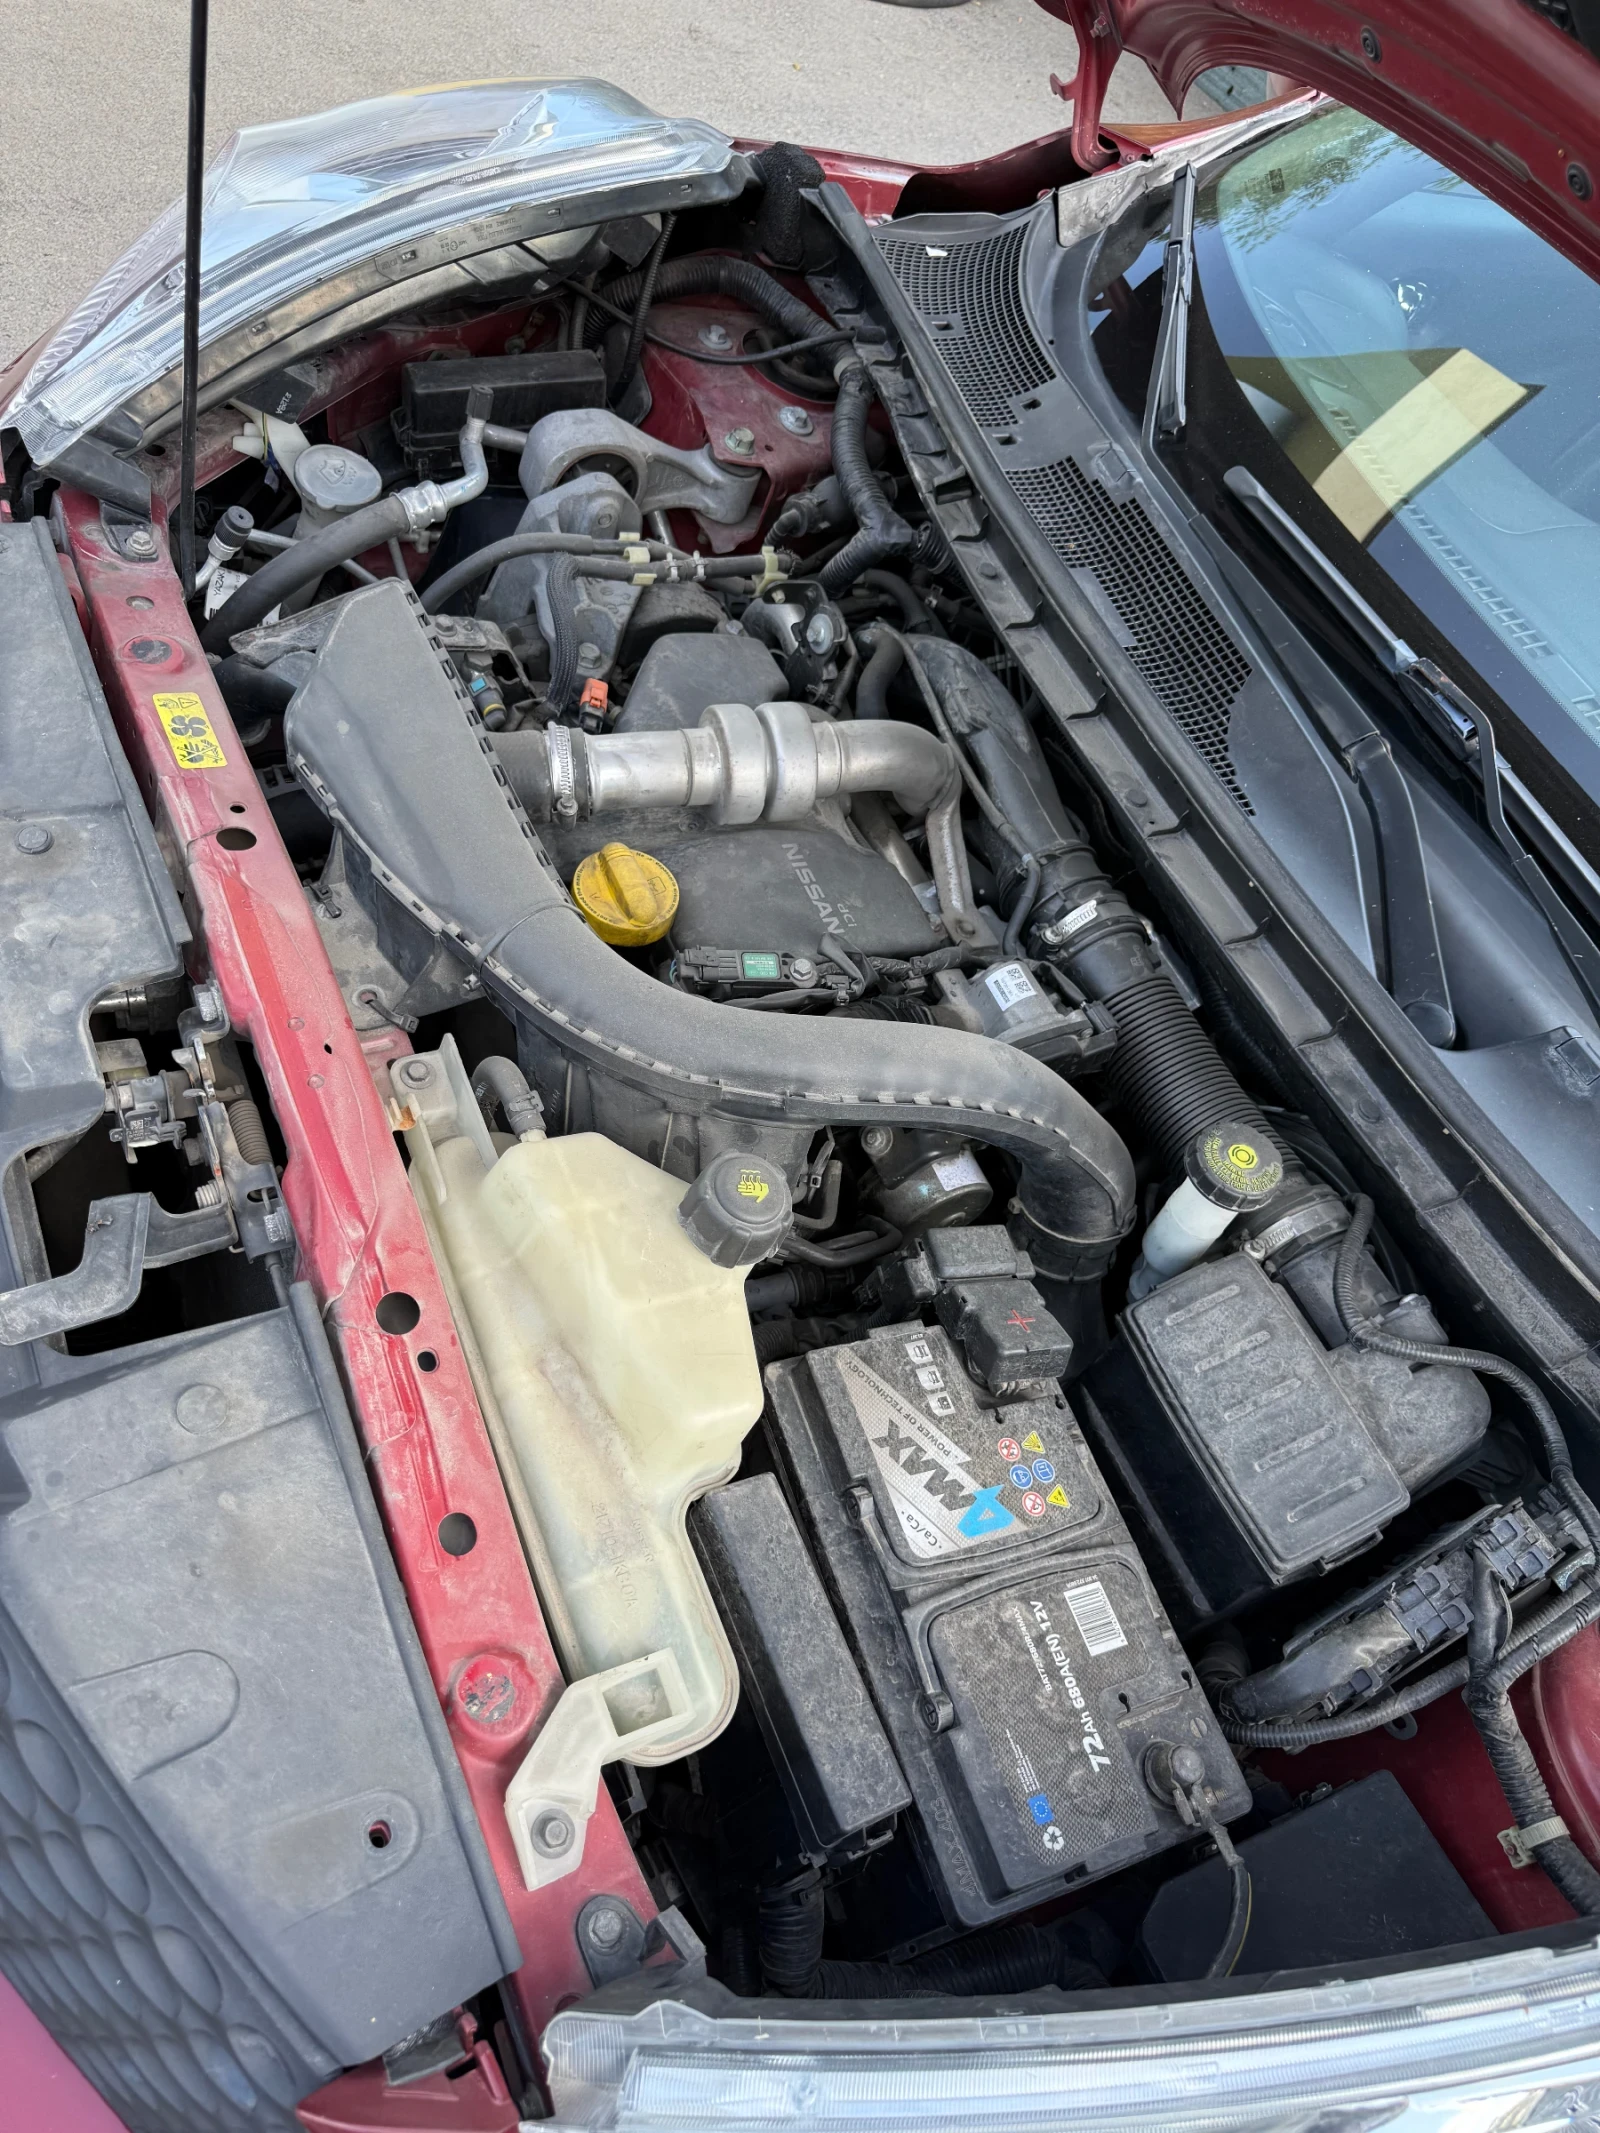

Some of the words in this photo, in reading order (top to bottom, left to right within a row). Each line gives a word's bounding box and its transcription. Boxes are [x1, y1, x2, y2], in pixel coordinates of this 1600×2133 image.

[781, 843, 845, 932] NISSAN
[837, 905, 857, 927] dCi
[846, 1359, 904, 1413] TECHNOLOGY
[903, 1412, 919, 1426] OF
[917, 1424, 953, 1457] POWER
[871, 1418, 1015, 1540] 4MAX
[906, 1514, 937, 1547] Ca/Ca
[1029, 1601, 1053, 1632] 12V
[1045, 1632, 1086, 1710] 680A(EN)
[1078, 1711, 1111, 1774] 72Ah
